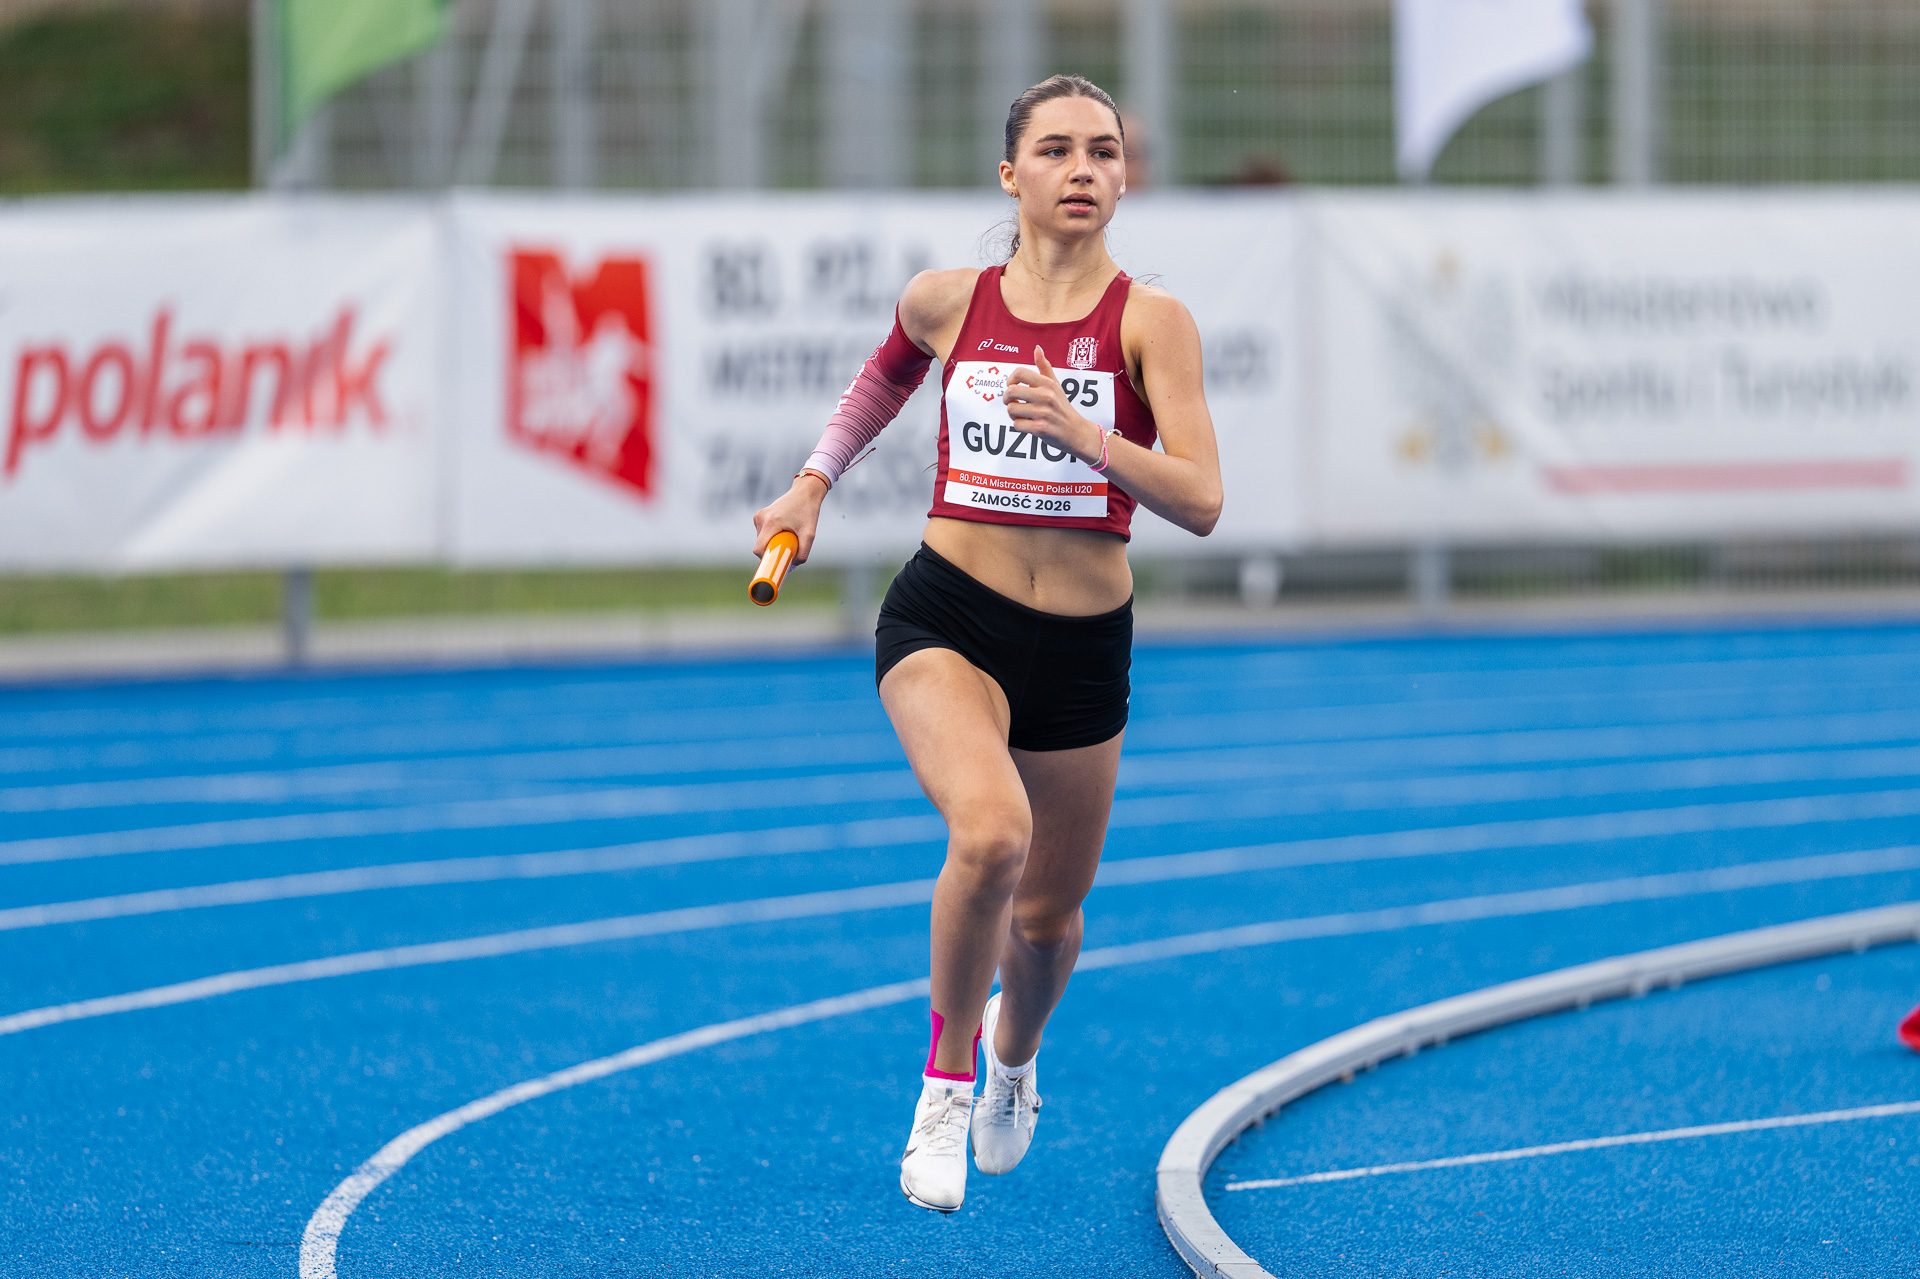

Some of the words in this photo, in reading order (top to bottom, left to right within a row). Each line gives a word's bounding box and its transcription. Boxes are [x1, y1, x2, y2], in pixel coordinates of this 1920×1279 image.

[994, 343, 1019, 353] CUNA
[975, 378, 1004, 388] ZAMOŚĆ
[959, 472, 970, 483] 80.
[972, 475, 988, 486] PZLA
[989, 478, 1044, 492] Mistrzostwa
[1046, 484, 1073, 493] Polski
[1074, 485, 1093, 494] U20
[971, 491, 1032, 509] ZAMOŚĆ
[1035, 498, 1072, 512] 2026
